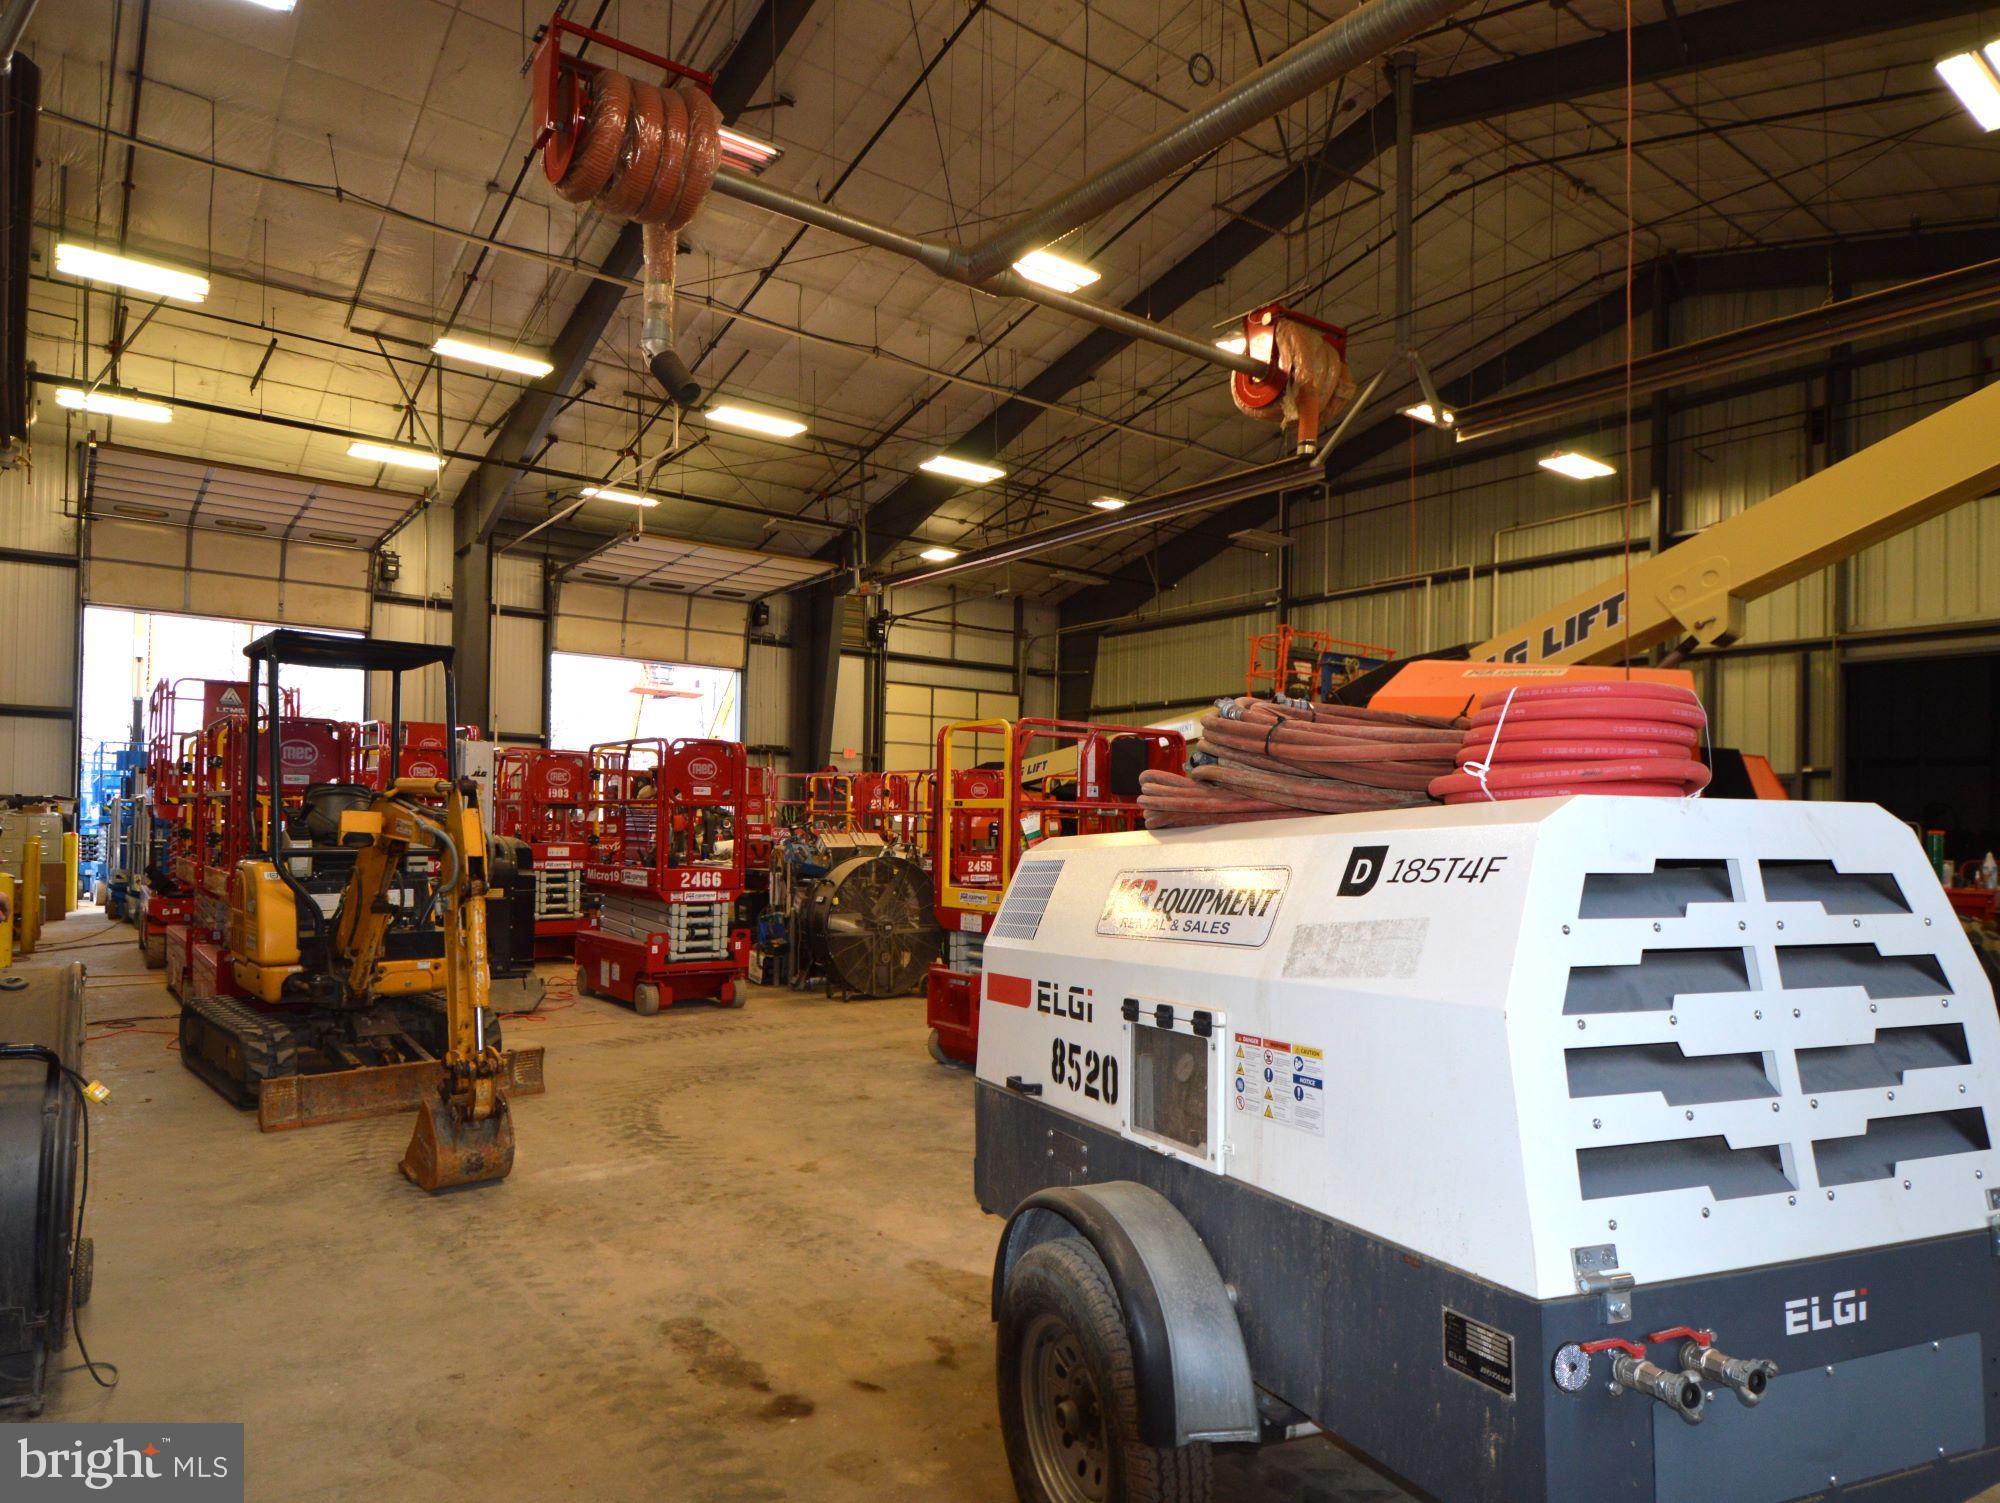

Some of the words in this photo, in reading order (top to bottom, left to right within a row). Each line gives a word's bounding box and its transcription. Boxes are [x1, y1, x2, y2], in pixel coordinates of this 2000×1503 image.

[1541, 591, 1625, 659] LIFT
[471, 770, 488, 778] JLG
[1027, 760, 1048, 775] LIFT
[967, 861, 993, 873] 2459
[1386, 856, 1508, 884] 185T4F
[587, 868, 620, 882] Micro19
[680, 872, 723, 888] 2466
[1153, 887, 1282, 922] EQUIPMENT
[1169, 919, 1179, 931] &
[1182, 920, 1231, 935] SALES
[1300, 1048, 1321, 1057] CAUTION
[1051, 1037, 1119, 1105] 8520
[1299, 1077, 1316, 1087] NOTICE
